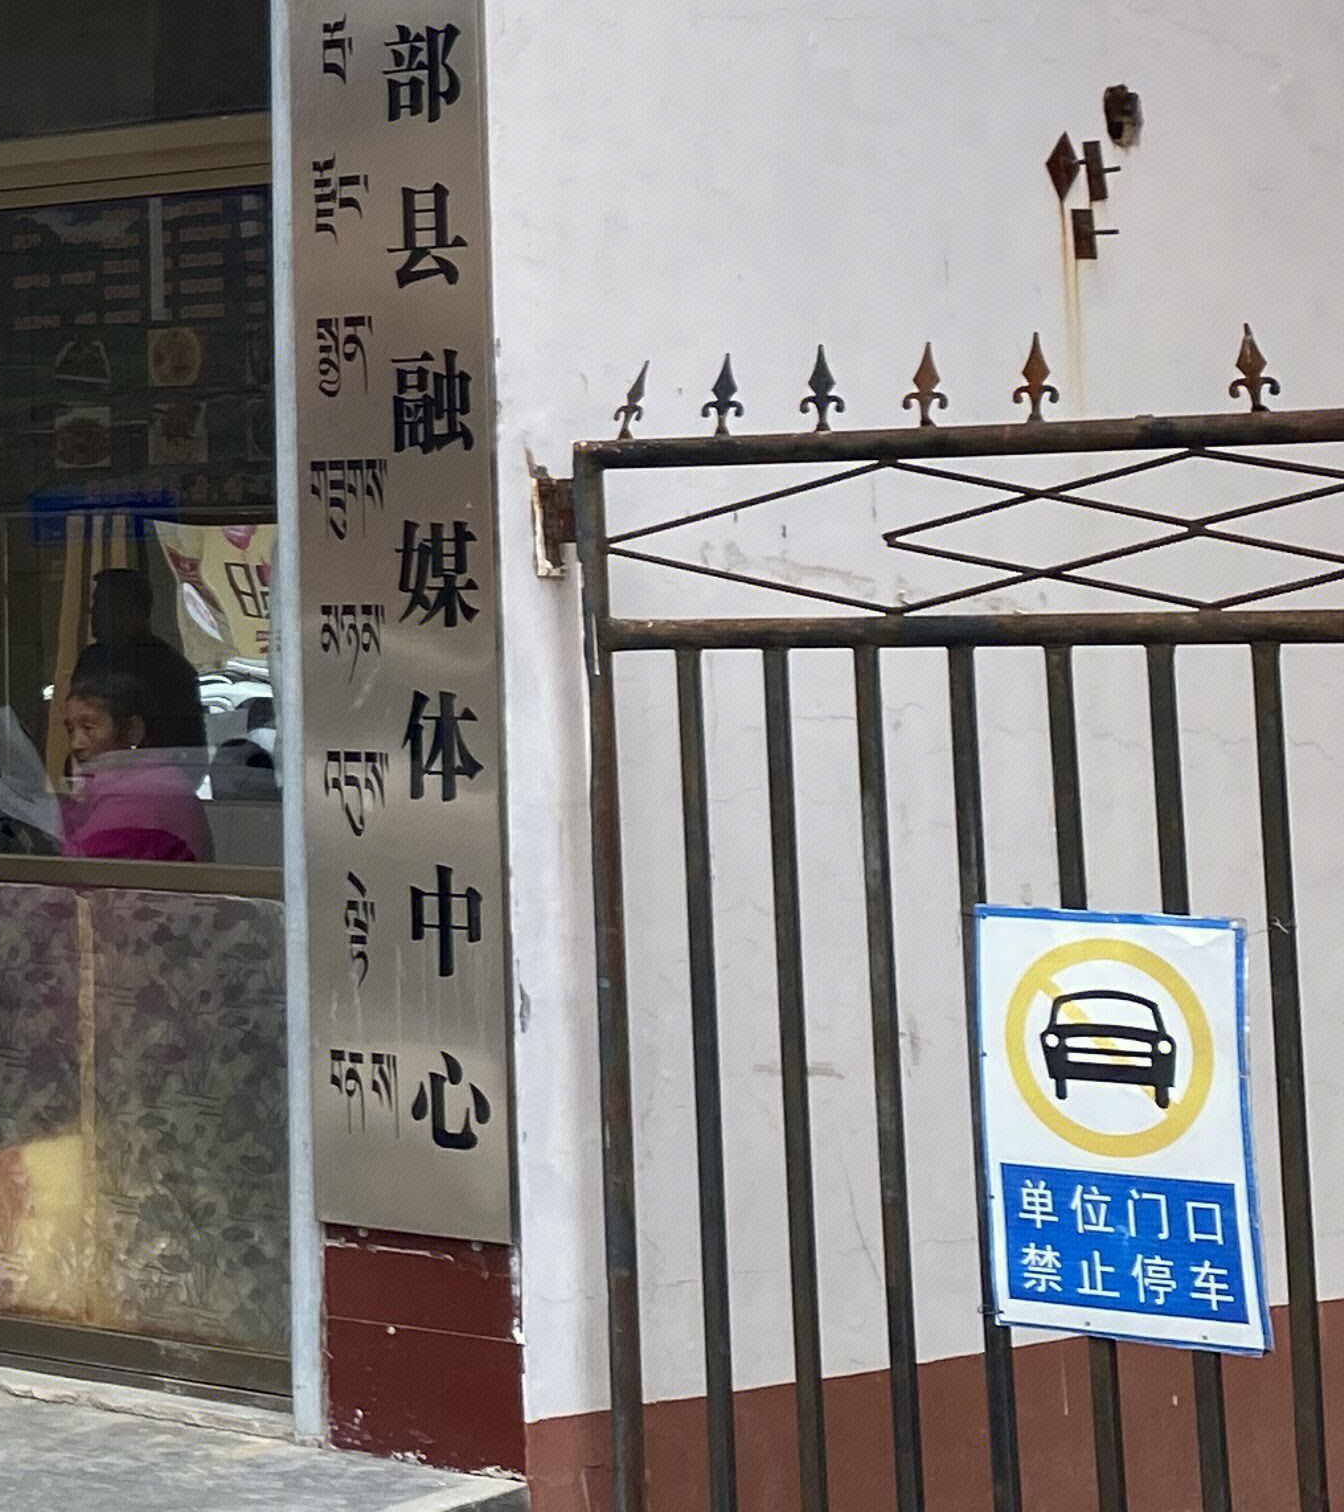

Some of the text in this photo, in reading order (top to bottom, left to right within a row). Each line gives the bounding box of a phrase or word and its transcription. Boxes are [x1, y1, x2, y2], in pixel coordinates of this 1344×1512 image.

[1018, 1179, 1225, 1246] 单位门口
[1020, 1241, 1235, 1312] 禁止停车
